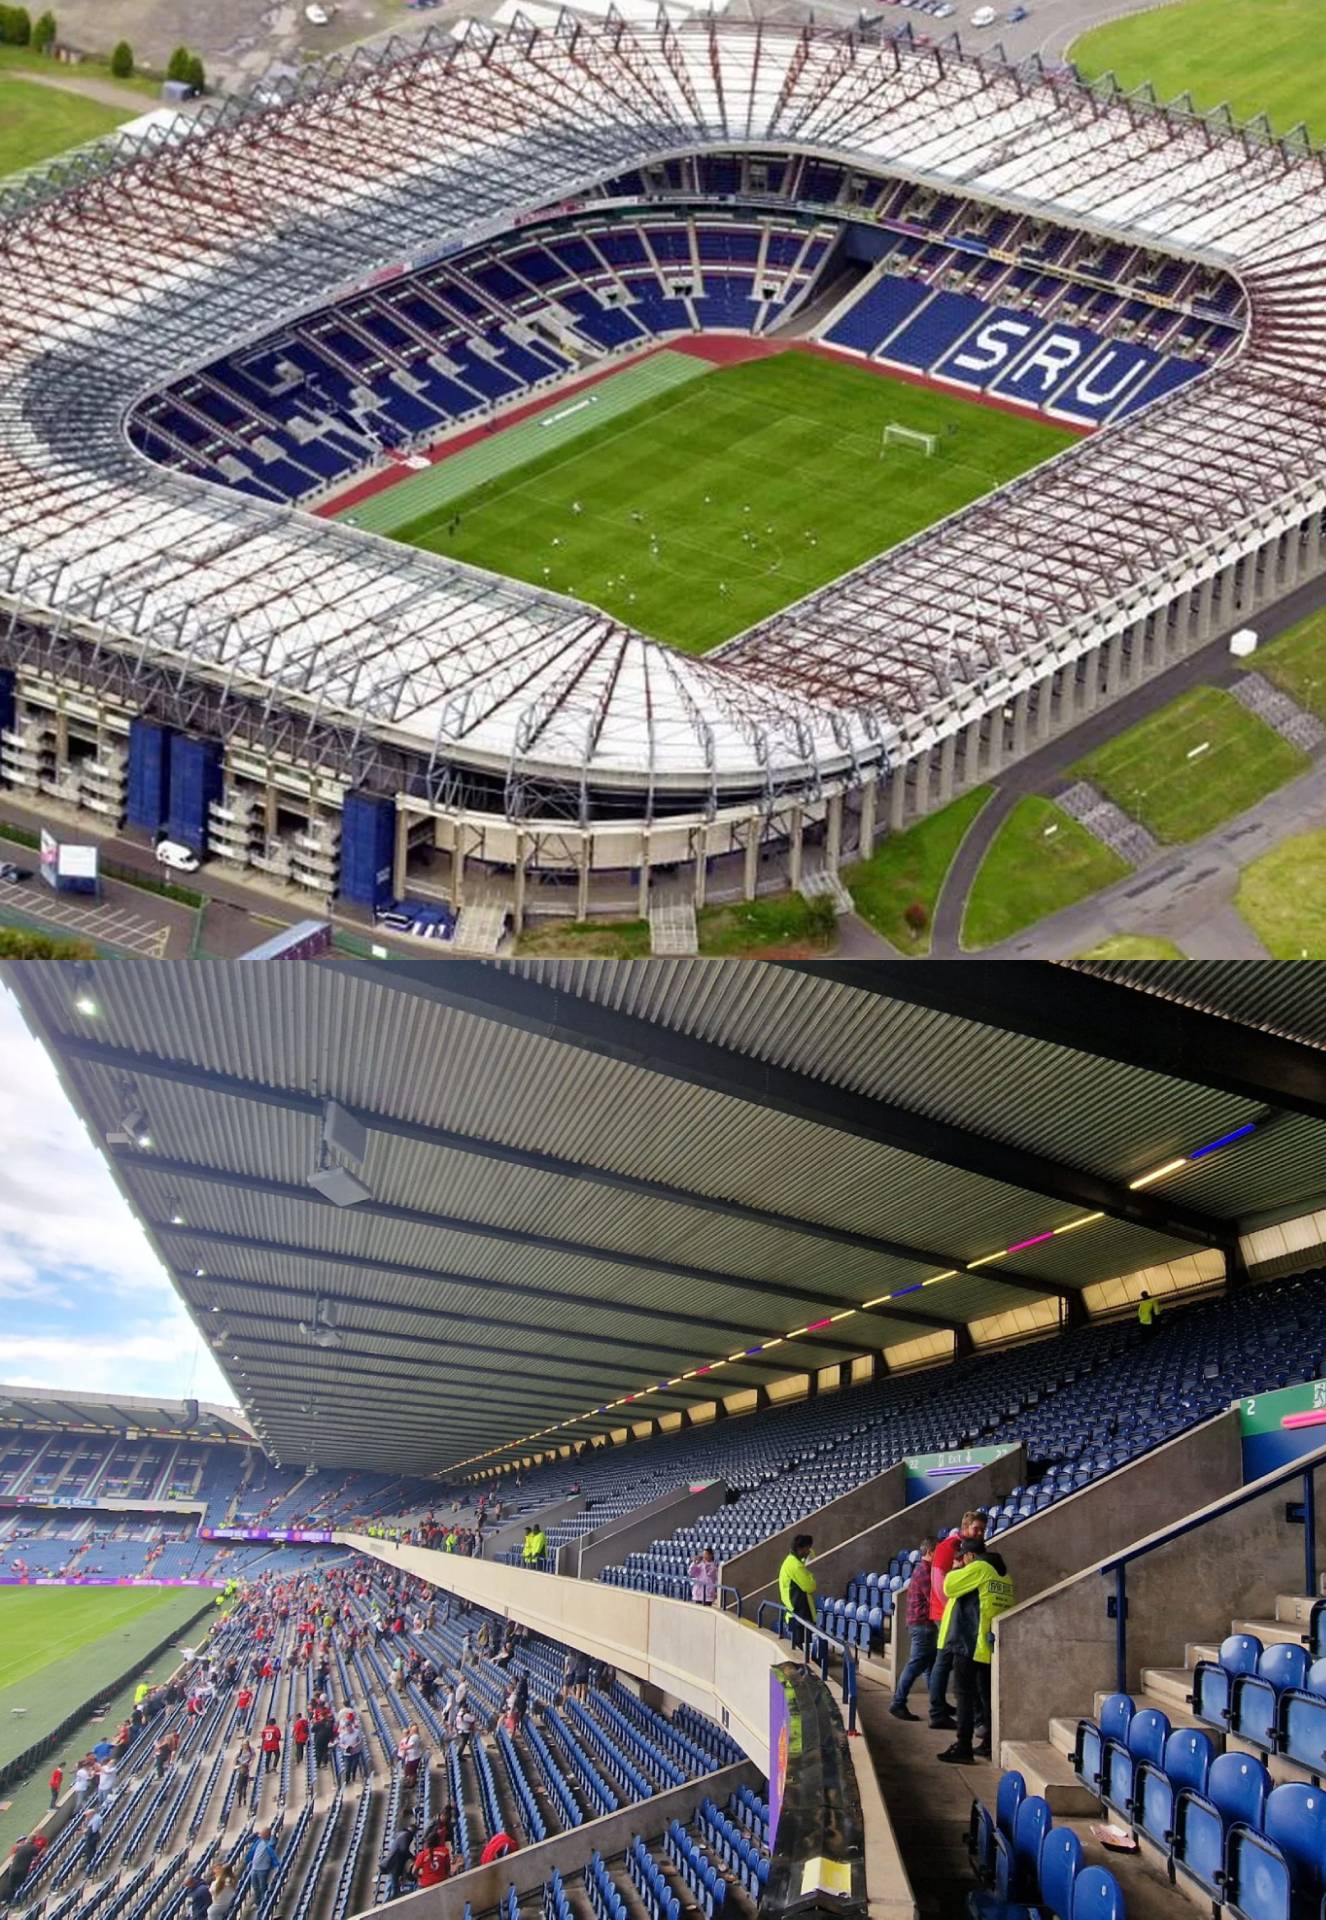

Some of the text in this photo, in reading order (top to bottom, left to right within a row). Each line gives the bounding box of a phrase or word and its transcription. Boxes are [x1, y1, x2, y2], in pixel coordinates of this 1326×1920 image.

[953, 319, 1147, 405] SRU
[1247, 1399, 1256, 1416] 2
[948, 1454, 961, 1465] Exit
